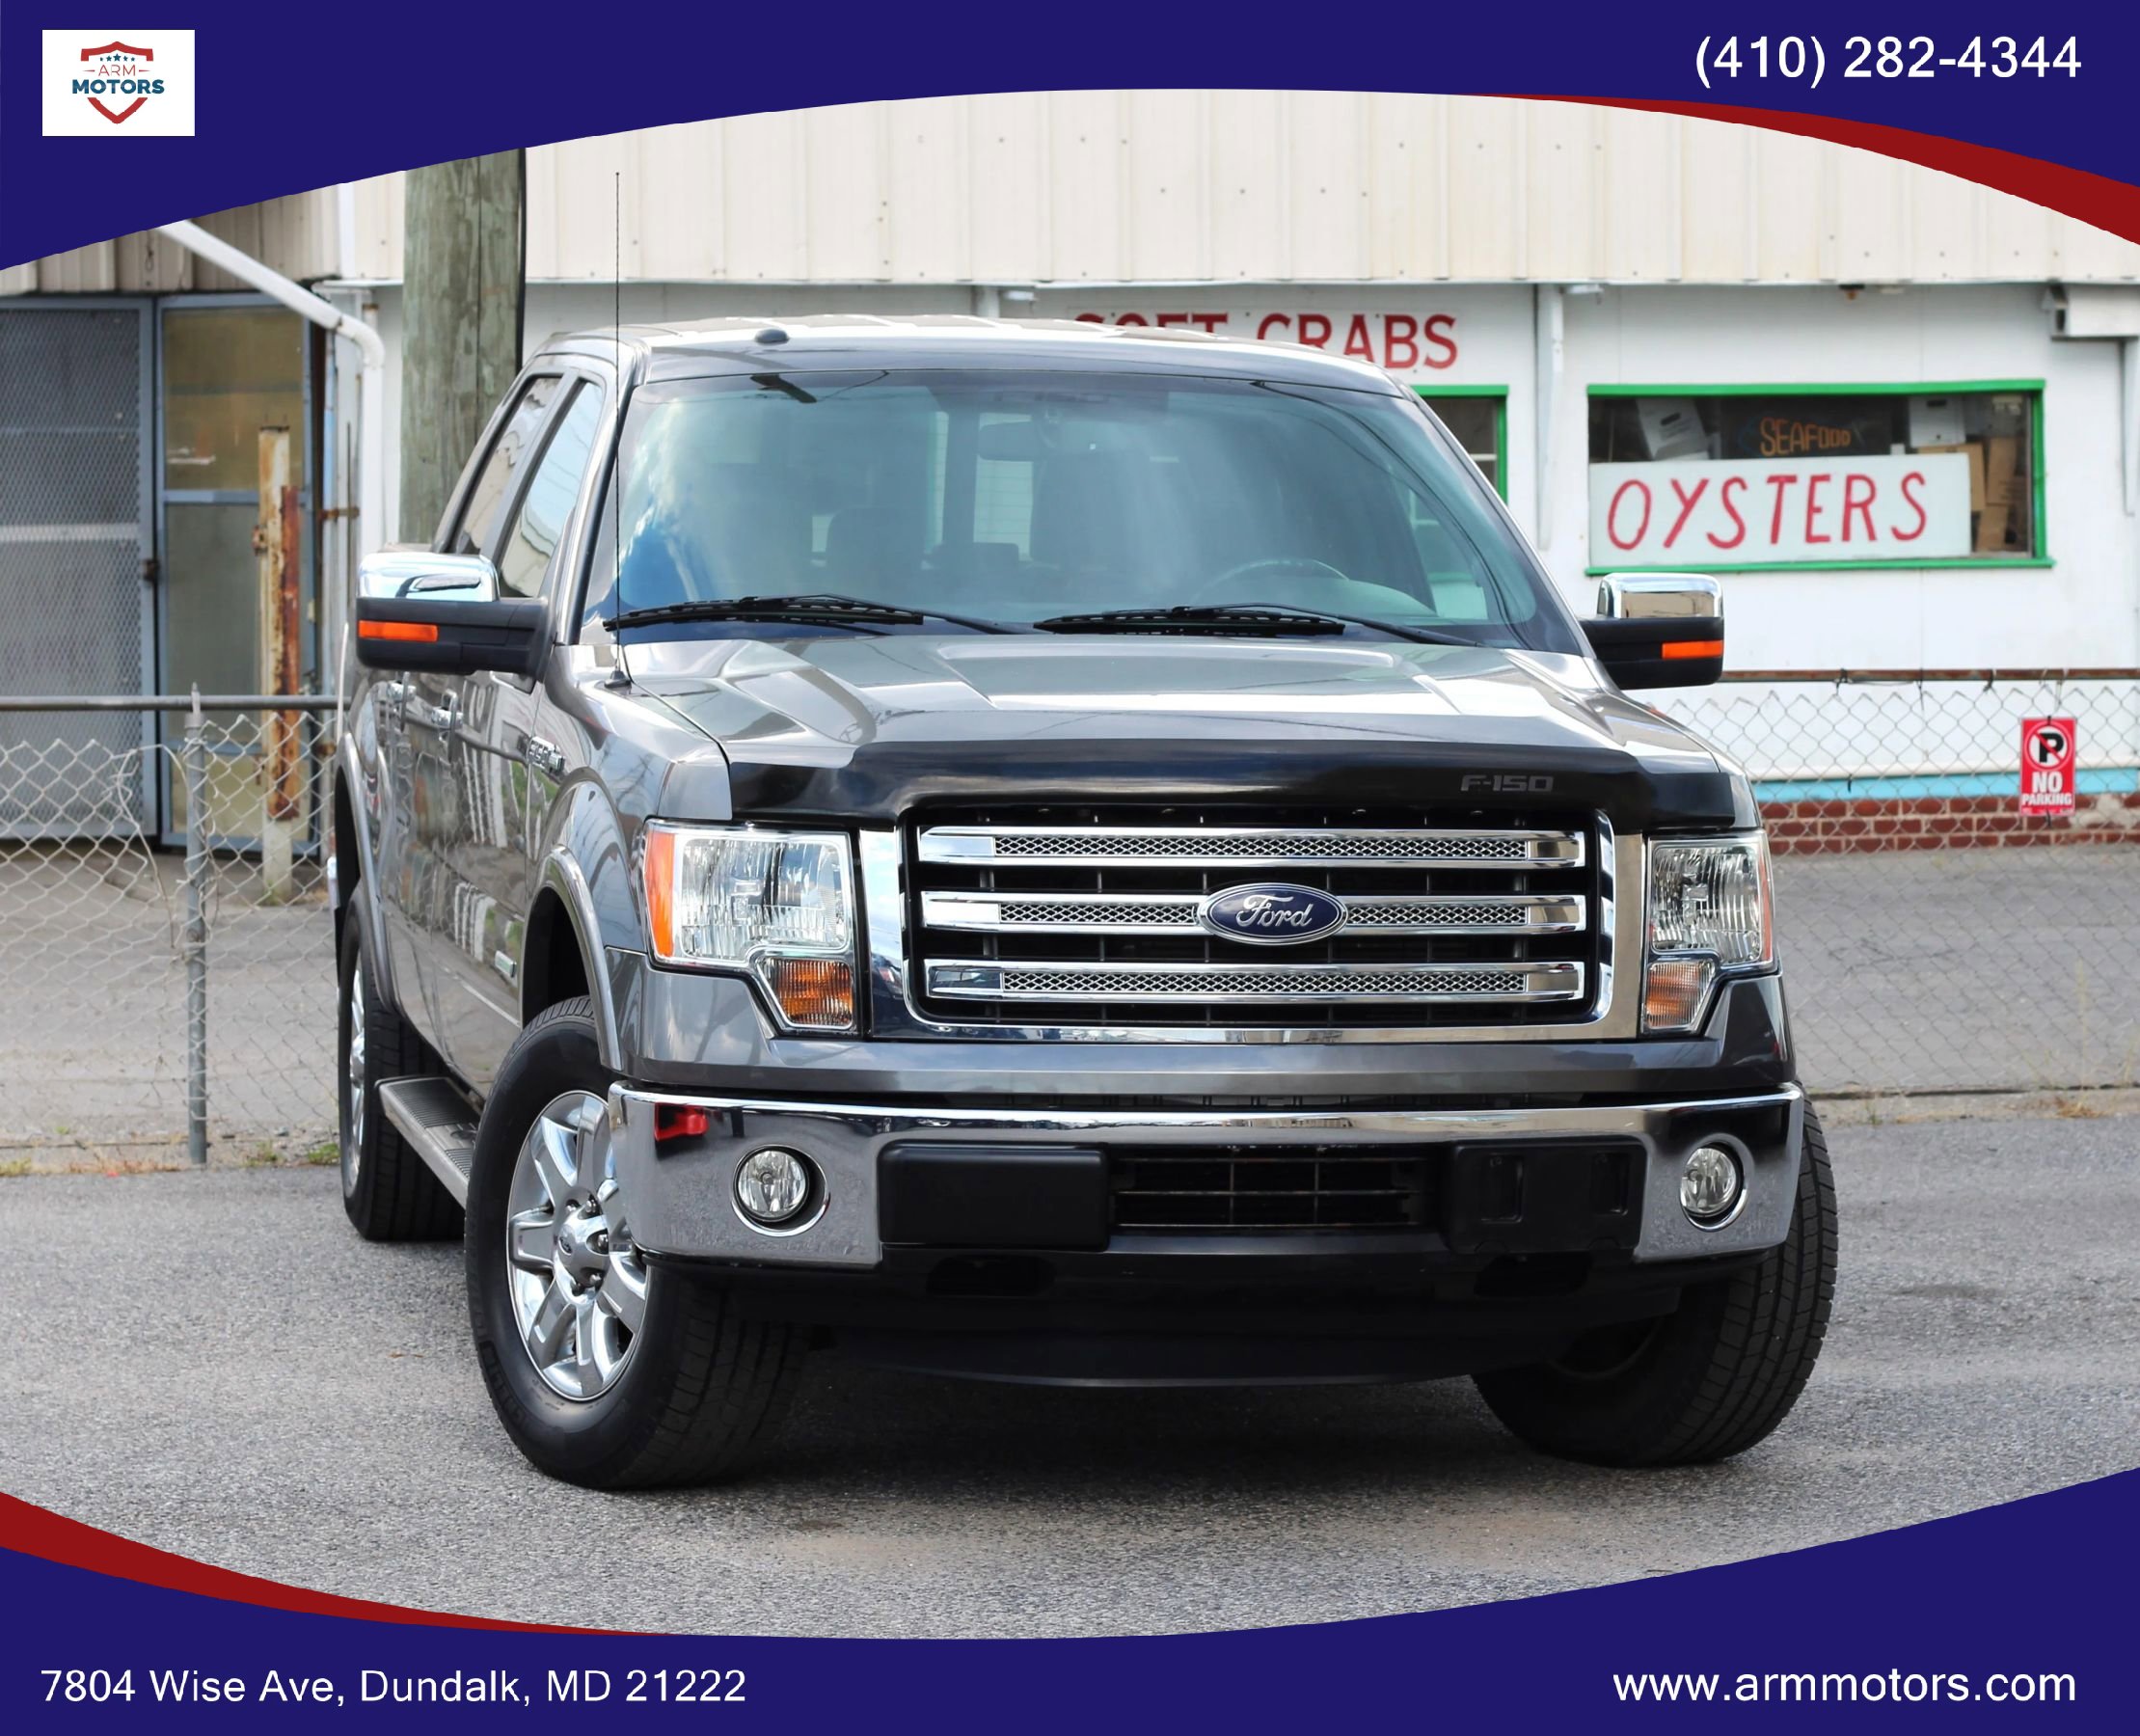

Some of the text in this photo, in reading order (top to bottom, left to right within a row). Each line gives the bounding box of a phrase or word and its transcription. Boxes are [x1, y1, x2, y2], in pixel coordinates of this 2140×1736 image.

[1760, 417, 1852, 457] SEAFOOD
[1608, 472, 1927, 551] OYSTERS
[1460, 774, 1555, 792] F-150
[2032, 771, 2064, 793] NO
[2022, 793, 2072, 806] PARKING
[1235, 894, 1314, 927] Ford
